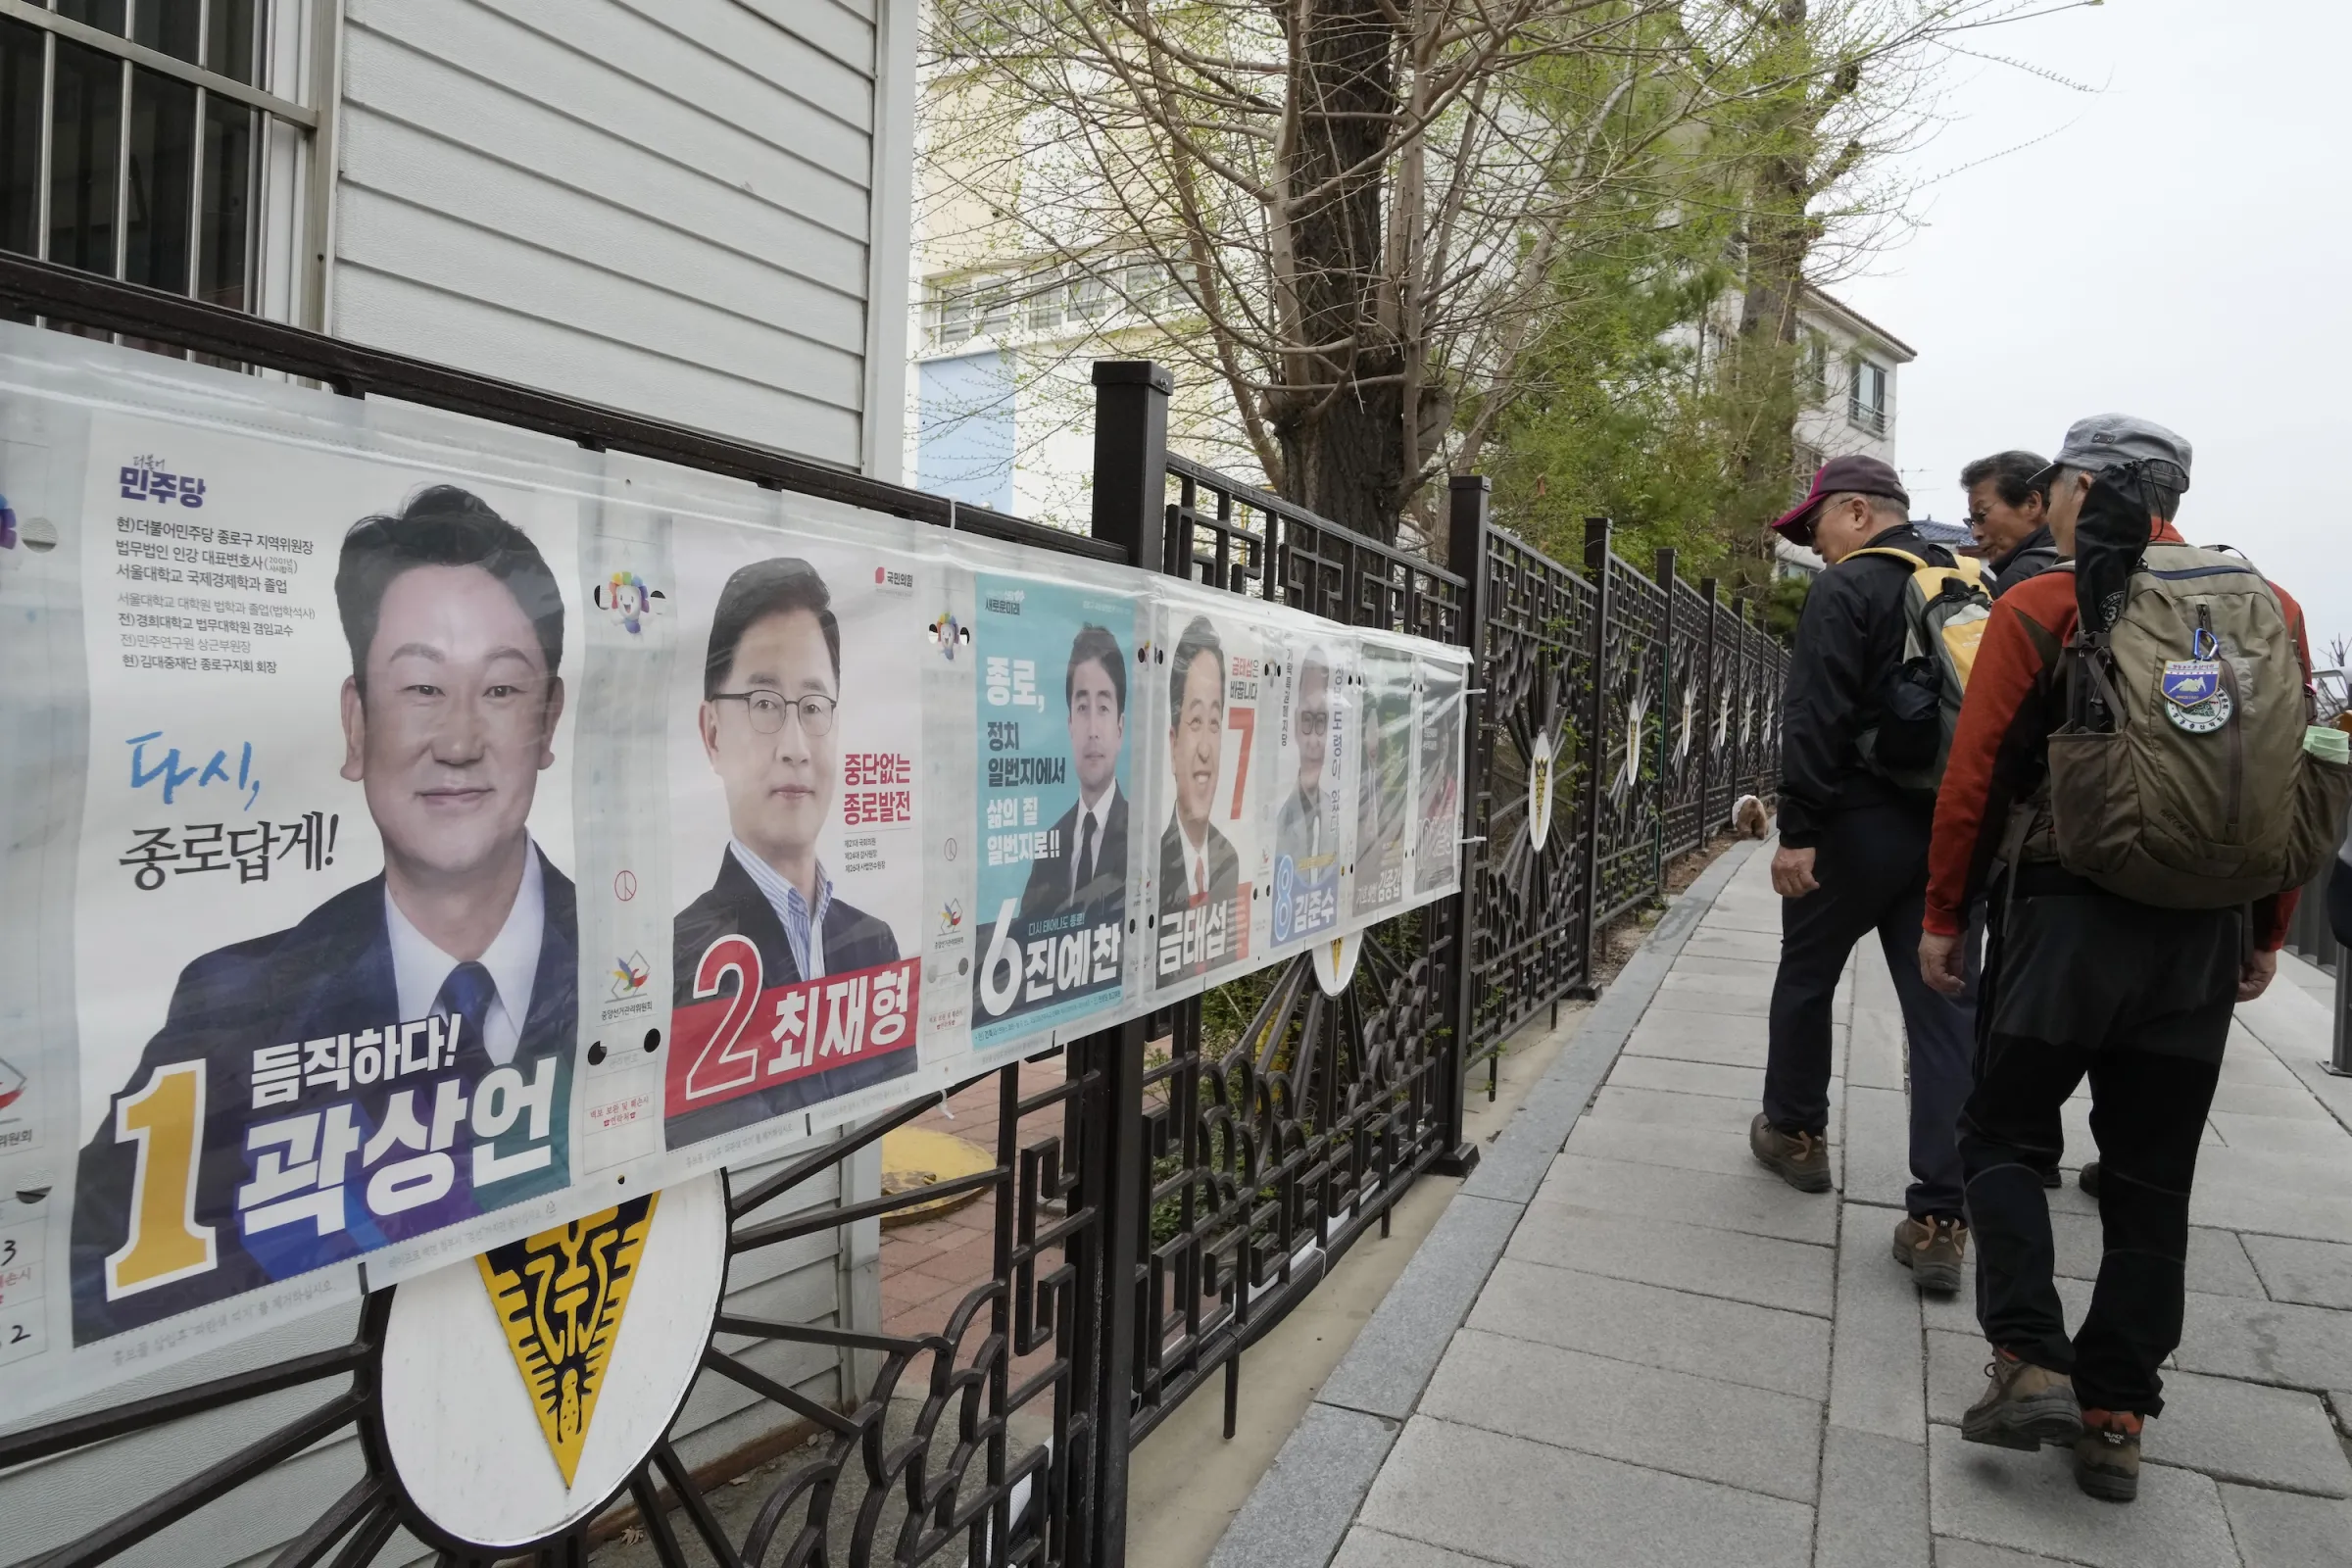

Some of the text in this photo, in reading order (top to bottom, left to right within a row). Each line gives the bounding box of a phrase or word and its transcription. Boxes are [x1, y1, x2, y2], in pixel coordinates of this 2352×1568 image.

[120, 466, 206, 508] 민주당
[116, 540, 169, 560] 법무법인
[172, 547, 198, 564] 인강
[218, 529, 253, 548] 종로구
[257, 535, 314, 555] 지역위원장
[116, 564, 287, 594] 서울대학교 국제경제학과 졸업
[887, 570, 914, 588] 국민의힘
[118, 592, 174, 608] 서울대학교
[178, 597, 211, 612] 대학원
[214, 601, 246, 615] 법학과
[984, 598, 1020, 615] 새로운미래
[196, 618, 251, 635] 법무대학원
[253, 623, 294, 637] 겸임교수
[197, 638, 251, 654] 상근부원장
[200, 658, 254, 673] 종로구지회
[256, 661, 277, 674] 회장
[1232, 657, 1259, 678] 금태섭은
[986, 657, 1045, 713] 종로,
[987, 721, 1019, 752] 정치
[124, 731, 262, 811] 다시,
[845, 753, 910, 786] 중단없는
[988, 758, 1065, 787] 일번지에서
[1228, 707, 1255, 820] 7
[844, 791, 910, 825] 종로발전
[987, 796, 1038, 829] 삶의 질
[118, 811, 341, 891] 종로답게!
[987, 830, 1060, 866] 일번지로!!
[1275, 855, 1294, 942] 8
[1294, 887, 1335, 933] 김준수
[1378, 865, 1401, 903] 김종갑
[1159, 900, 1228, 976] 금태섭
[980, 898, 1022, 1016] 6
[1025, 922, 1121, 1003] 진예찬
[601, 1001, 653, 1021] 중앙선거관리위원회
[685, 932, 911, 1102] 2 최재형
[251, 1013, 462, 1110] 듬직하다!
[104, 1054, 559, 1302] 1 곽상언
[10, 1324, 31, 1345] 2
